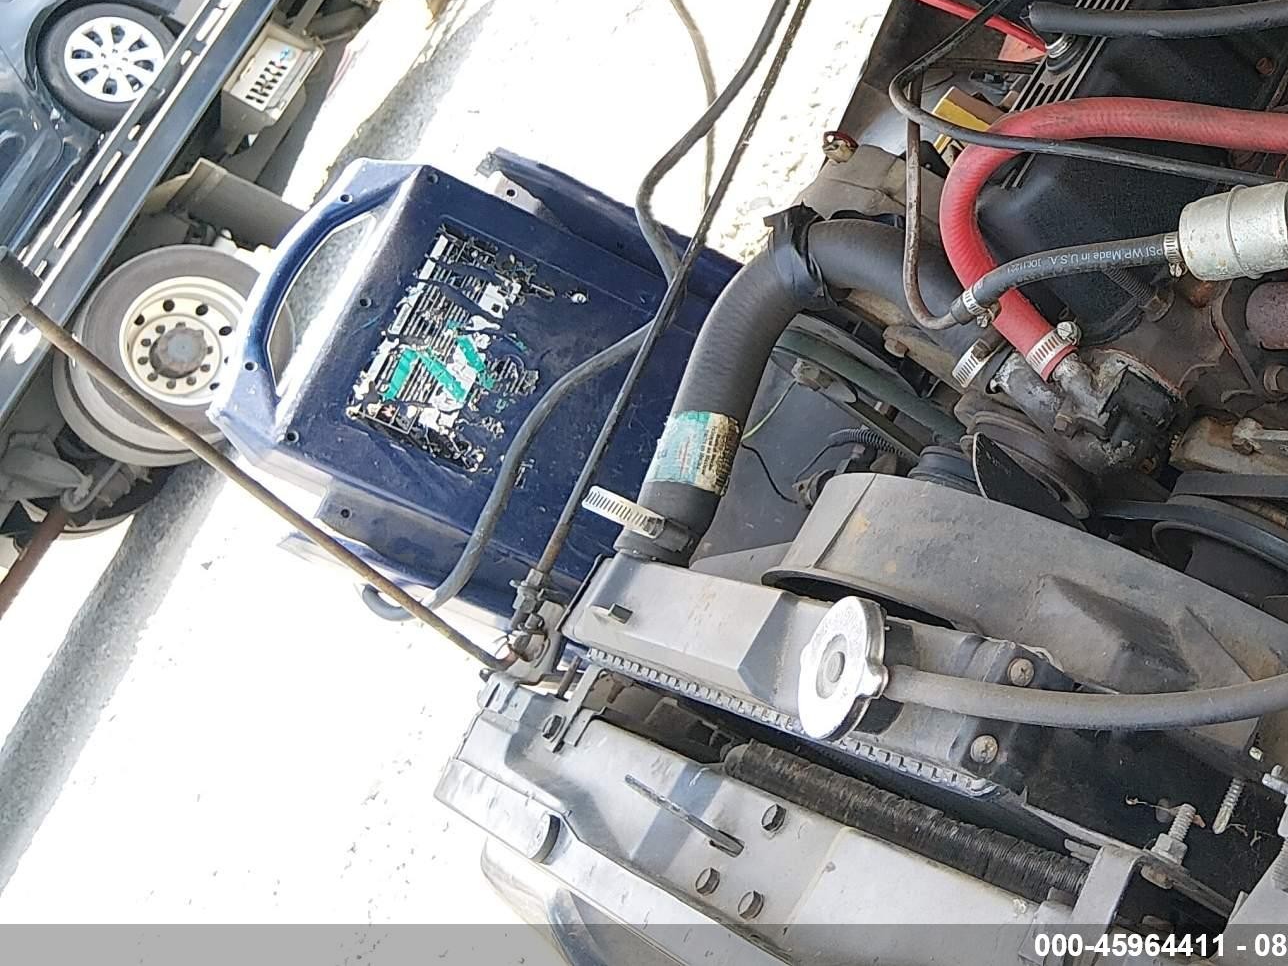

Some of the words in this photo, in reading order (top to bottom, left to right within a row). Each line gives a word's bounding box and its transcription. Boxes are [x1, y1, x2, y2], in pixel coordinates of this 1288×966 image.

[1081, 252, 1090, 262] in
[1092, 248, 1123, 261] Made
[1145, 246, 1164, 258] PSI
